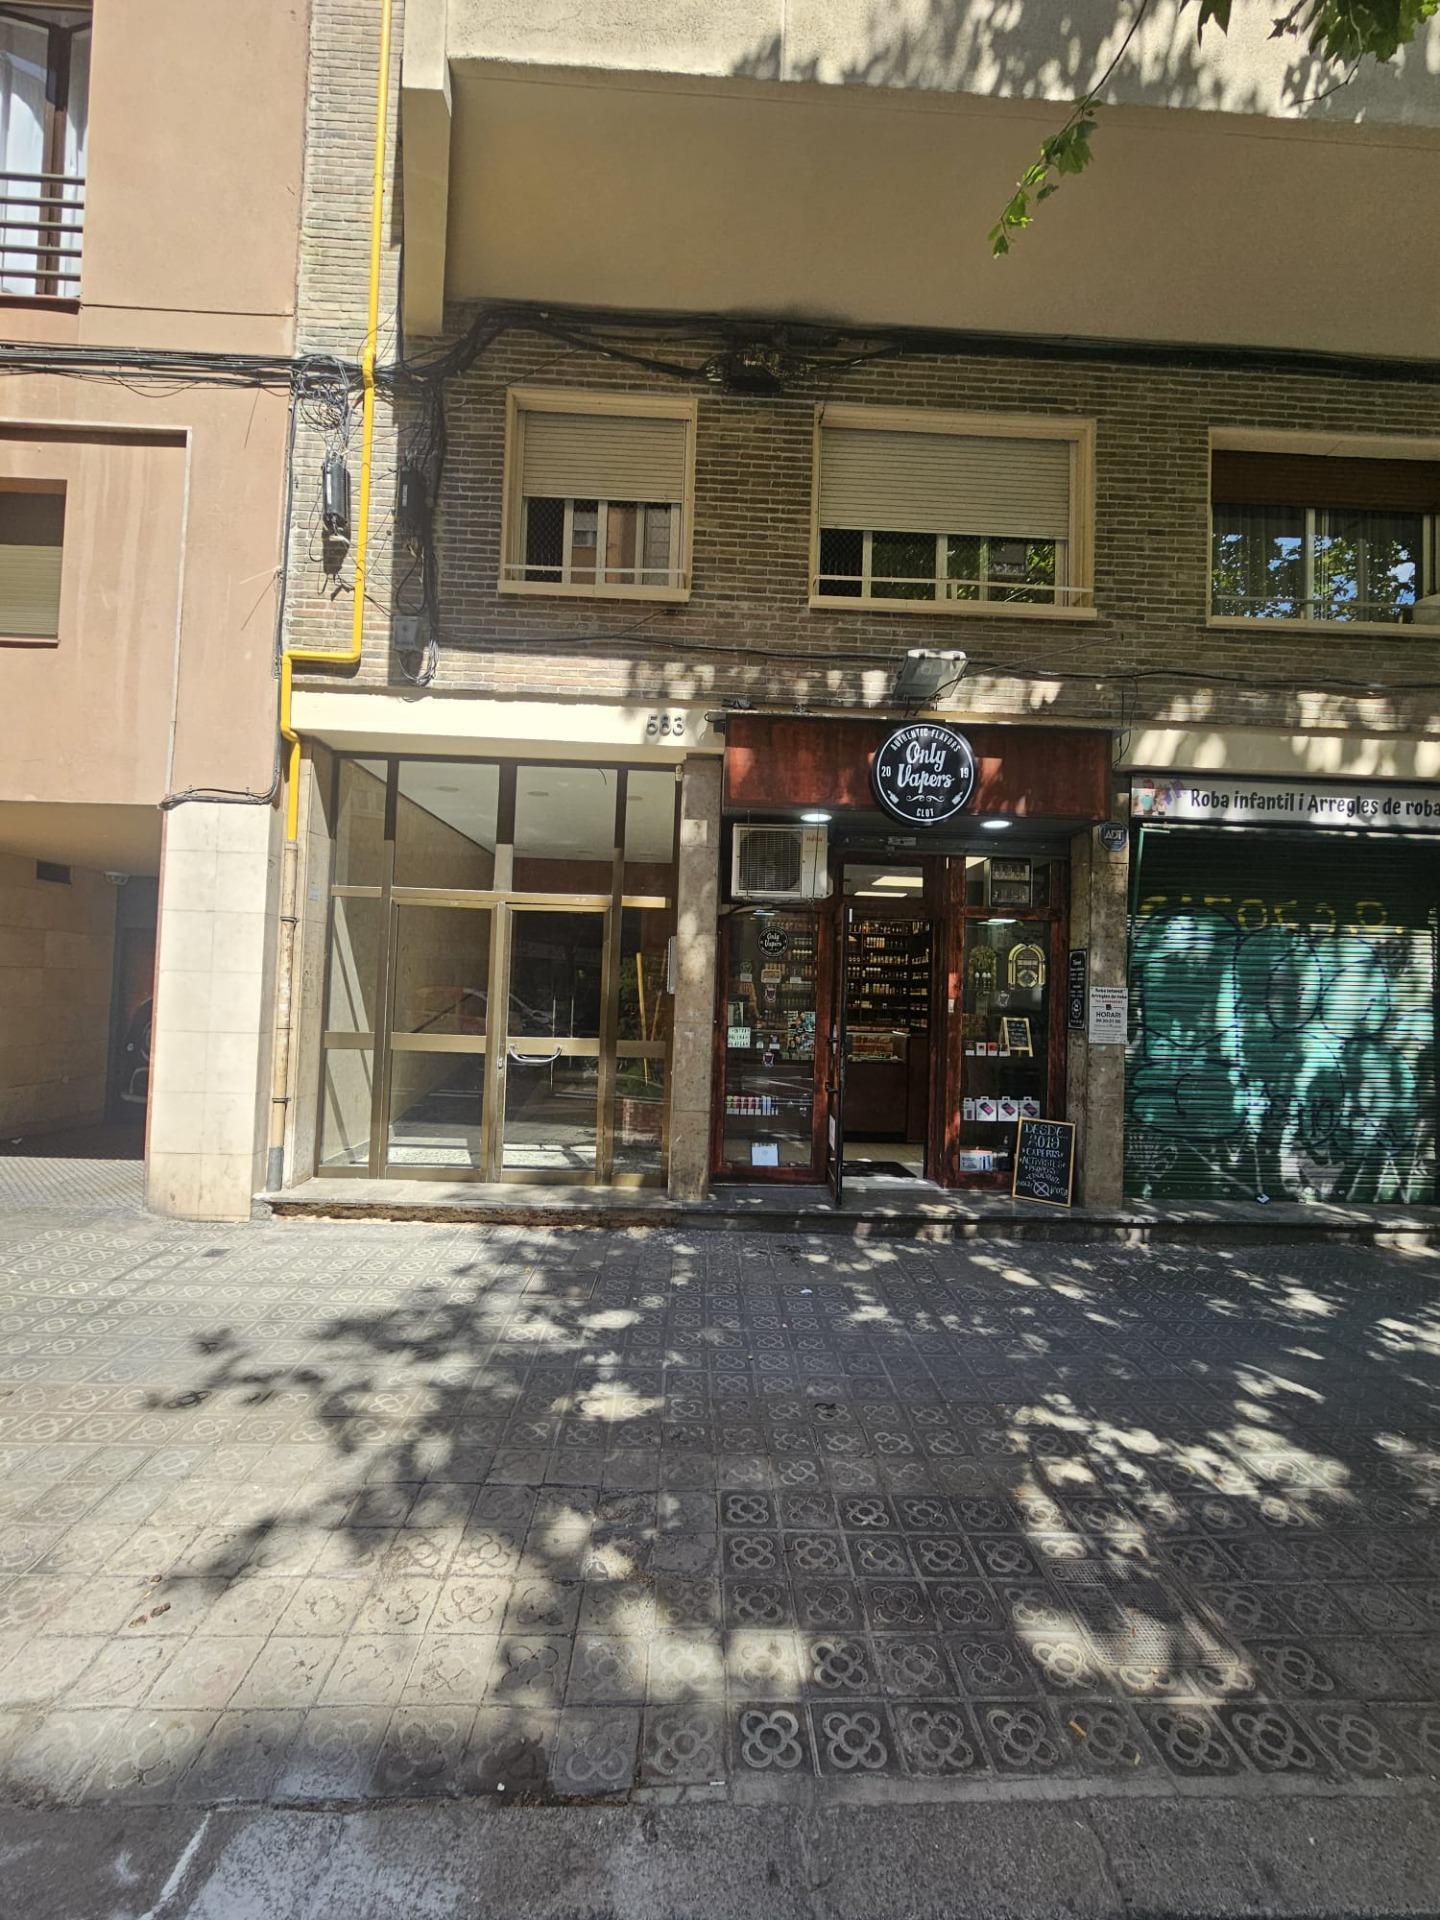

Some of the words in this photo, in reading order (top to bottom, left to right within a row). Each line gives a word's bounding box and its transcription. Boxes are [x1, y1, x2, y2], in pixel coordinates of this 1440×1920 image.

[645, 713, 685, 737] 583
[890, 728, 929, 752] AUTHENTIC
[931, 728, 961, 752] FLAVORS
[906, 740, 947, 772] Only
[881, 765, 892, 777] 20
[897, 763, 955, 794] Vapers
[959, 767, 970, 778] 19
[916, 807, 935, 818] CLOT
[1190, 788, 1230, 809] Roba
[1234, 790, 1295, 812] infantil
[1299, 792, 1305, 811] i
[1307, 793, 1379, 818] Arregles
[1382, 797, 1402, 815] de
[1406, 798, 1440, 817] roba
[1104, 829, 1124, 840] ADT
